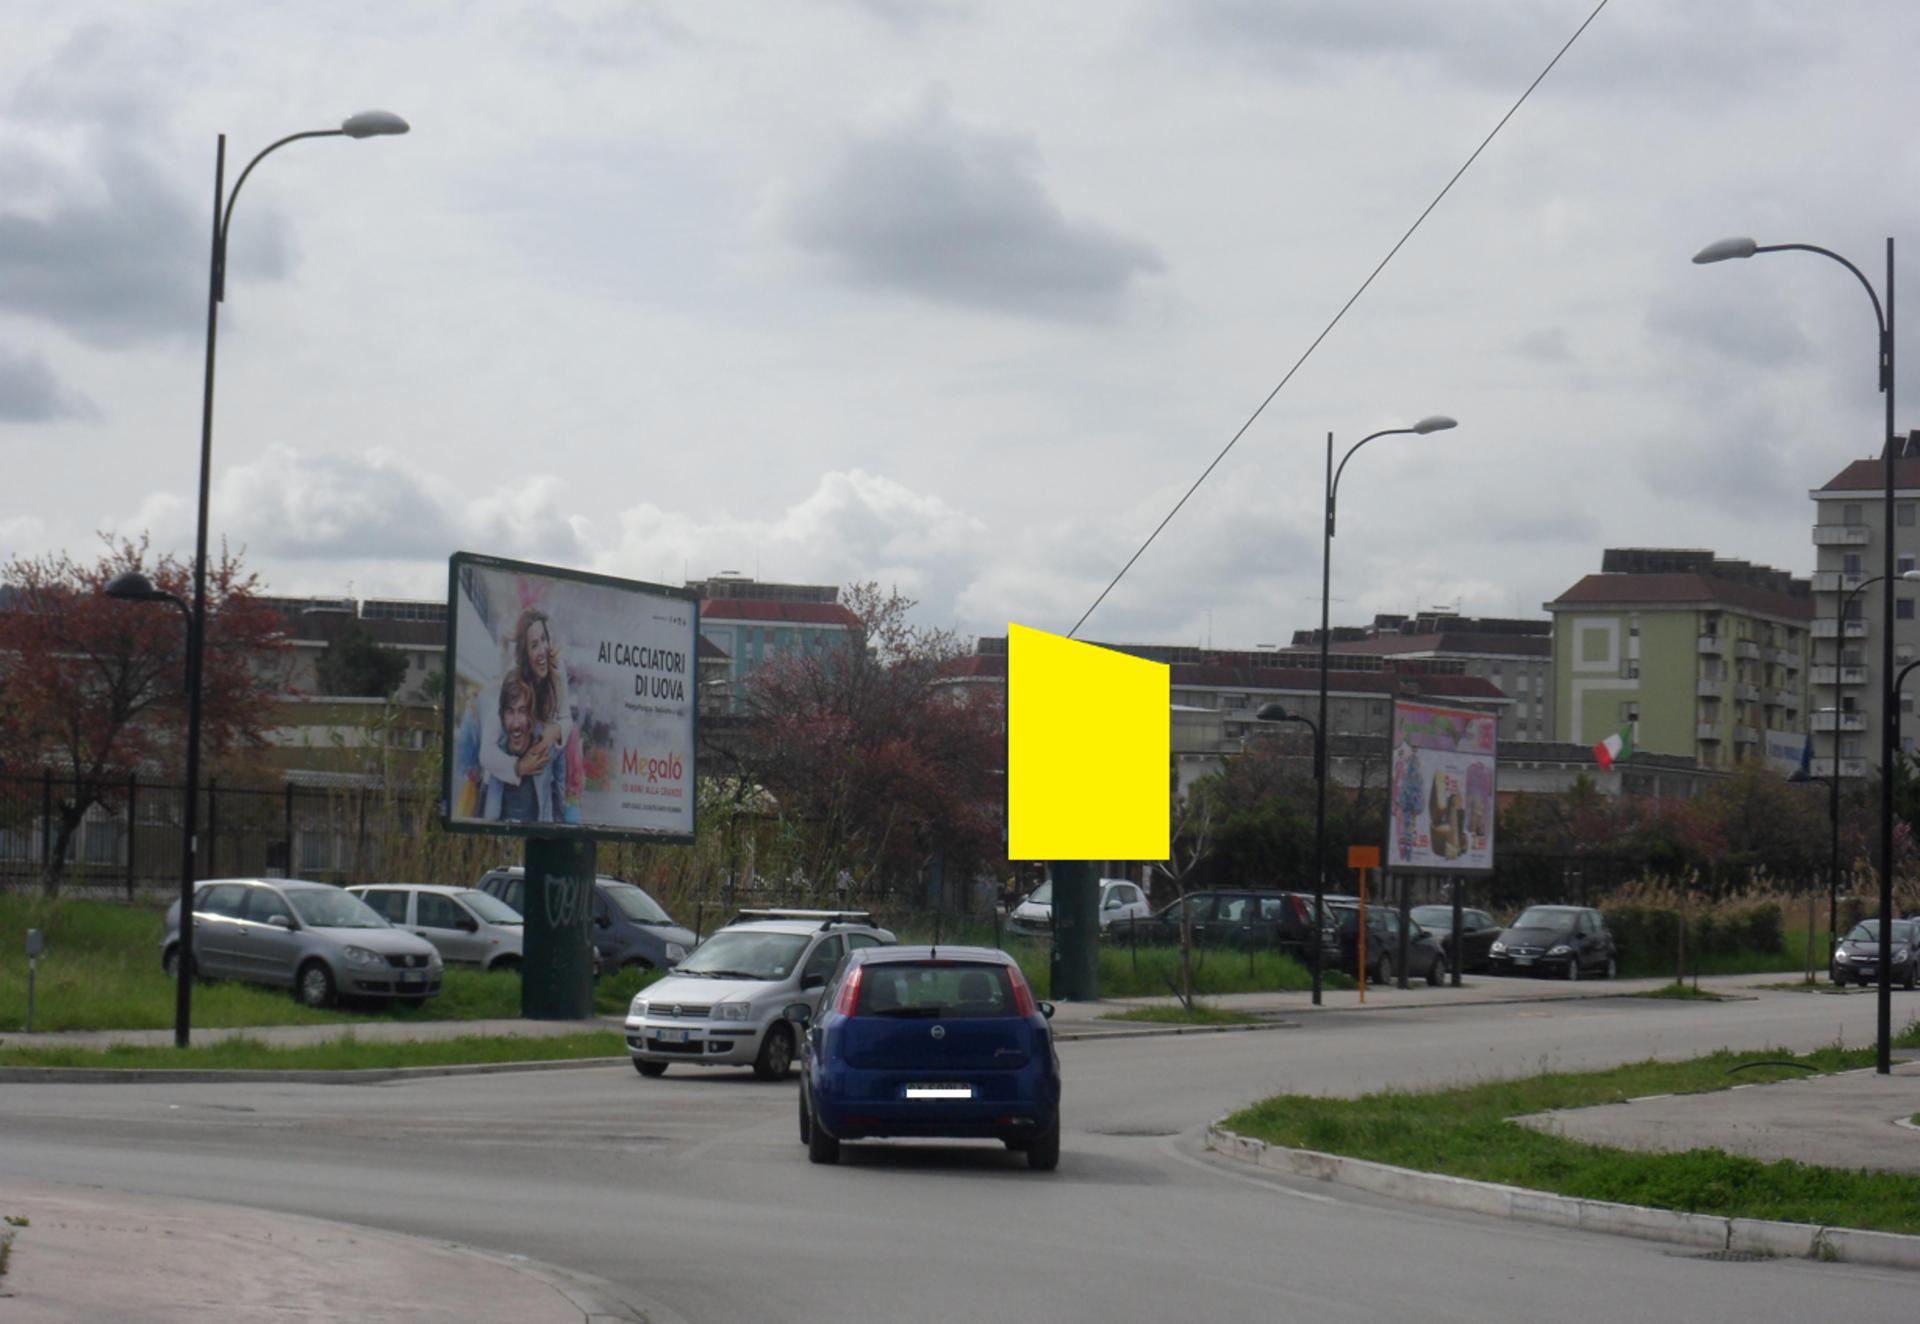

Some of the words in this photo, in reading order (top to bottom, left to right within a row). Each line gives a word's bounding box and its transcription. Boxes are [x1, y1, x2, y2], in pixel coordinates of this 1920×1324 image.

[598, 641, 611, 664] AI
[615, 643, 685, 674] CACCIATORI
[635, 674, 648, 697] DI
[651, 677, 684, 701] UOVA
